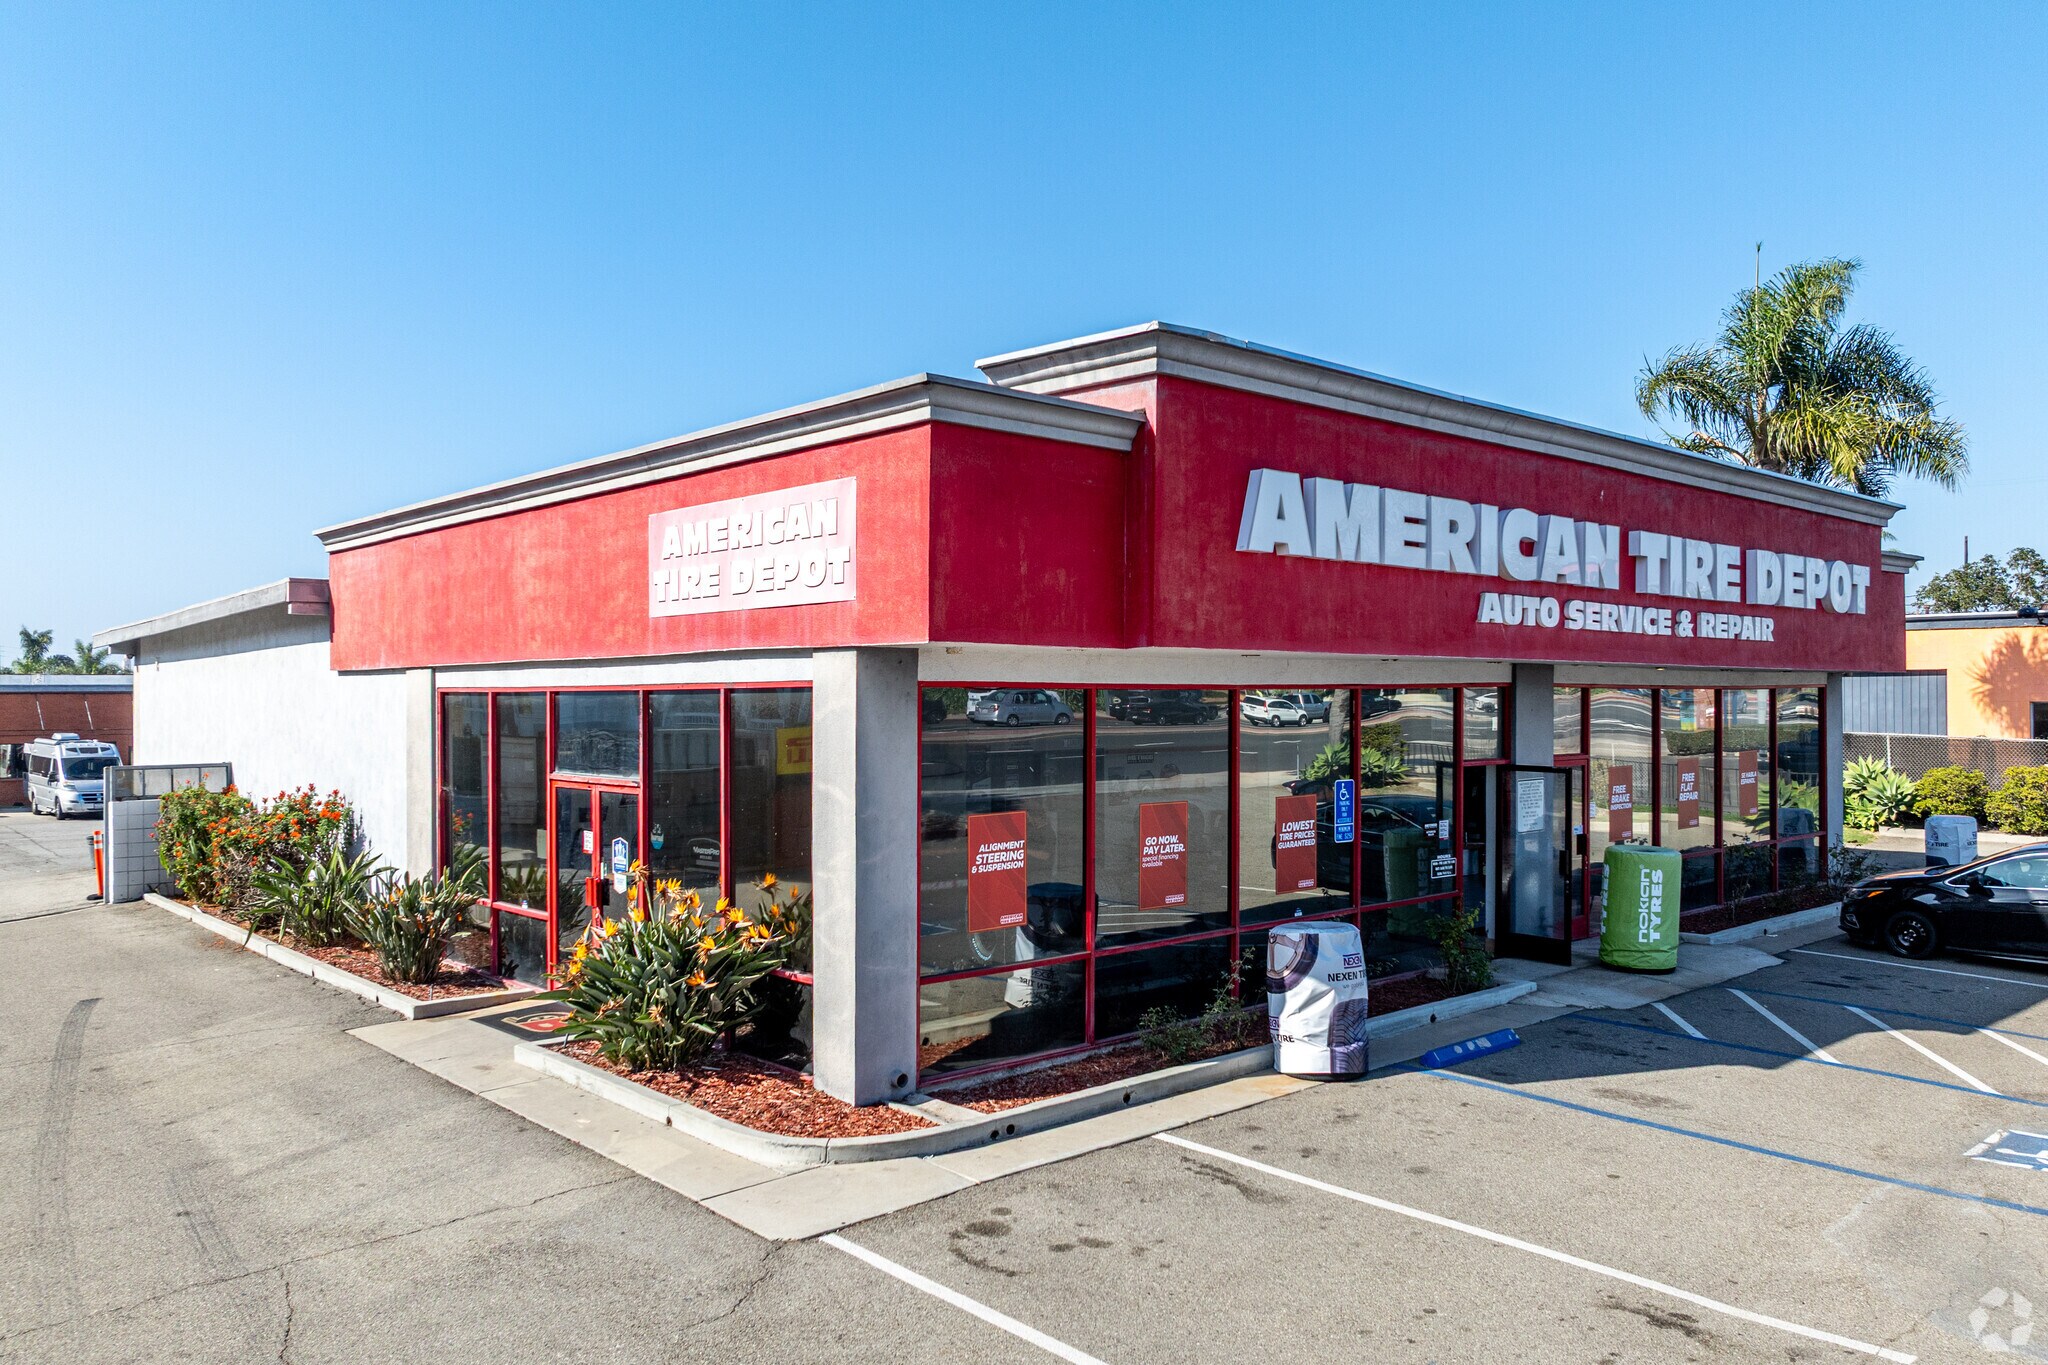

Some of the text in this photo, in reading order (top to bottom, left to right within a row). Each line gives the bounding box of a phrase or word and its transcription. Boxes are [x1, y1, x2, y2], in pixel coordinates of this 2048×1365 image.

[662, 498, 838, 560] AMERICAN
[1236, 468, 1870, 615] AMERICAN TIRE DEPOT
[653, 546, 850, 602] TIRE DEPOT
[1477, 592, 1774, 642] AUTO SERVICE & REPAIR
[1682, 772, 1695, 782] FREE
[1612, 784, 1627, 794] FREE
[1680, 782, 1694, 792] FLAT
[1611, 794, 1630, 803] BRAKE
[1679, 791, 1698, 801] REPAIR
[1610, 803, 1632, 811] INSPECTION
[1282, 820, 1315, 832] LOWEST
[1145, 835, 1179, 846] GO NOW.
[1279, 830, 1315, 841] TIRE PRICES
[979, 840, 1024, 853] ALIGNMENT
[1143, 843, 1185, 855] PAY LATER.
[1278, 840, 1316, 849] GUARANTEED
[975, 850, 1024, 865] STEERING
[1142, 853, 1179, 863] special financing
[971, 861, 1024, 874] & SUSPENSION
[1142, 860, 1163, 868] available
[1638, 868, 1650, 943] nokian
[1649, 869, 1663, 943] TYRES
[1327, 970, 1358, 982] NEXEN
